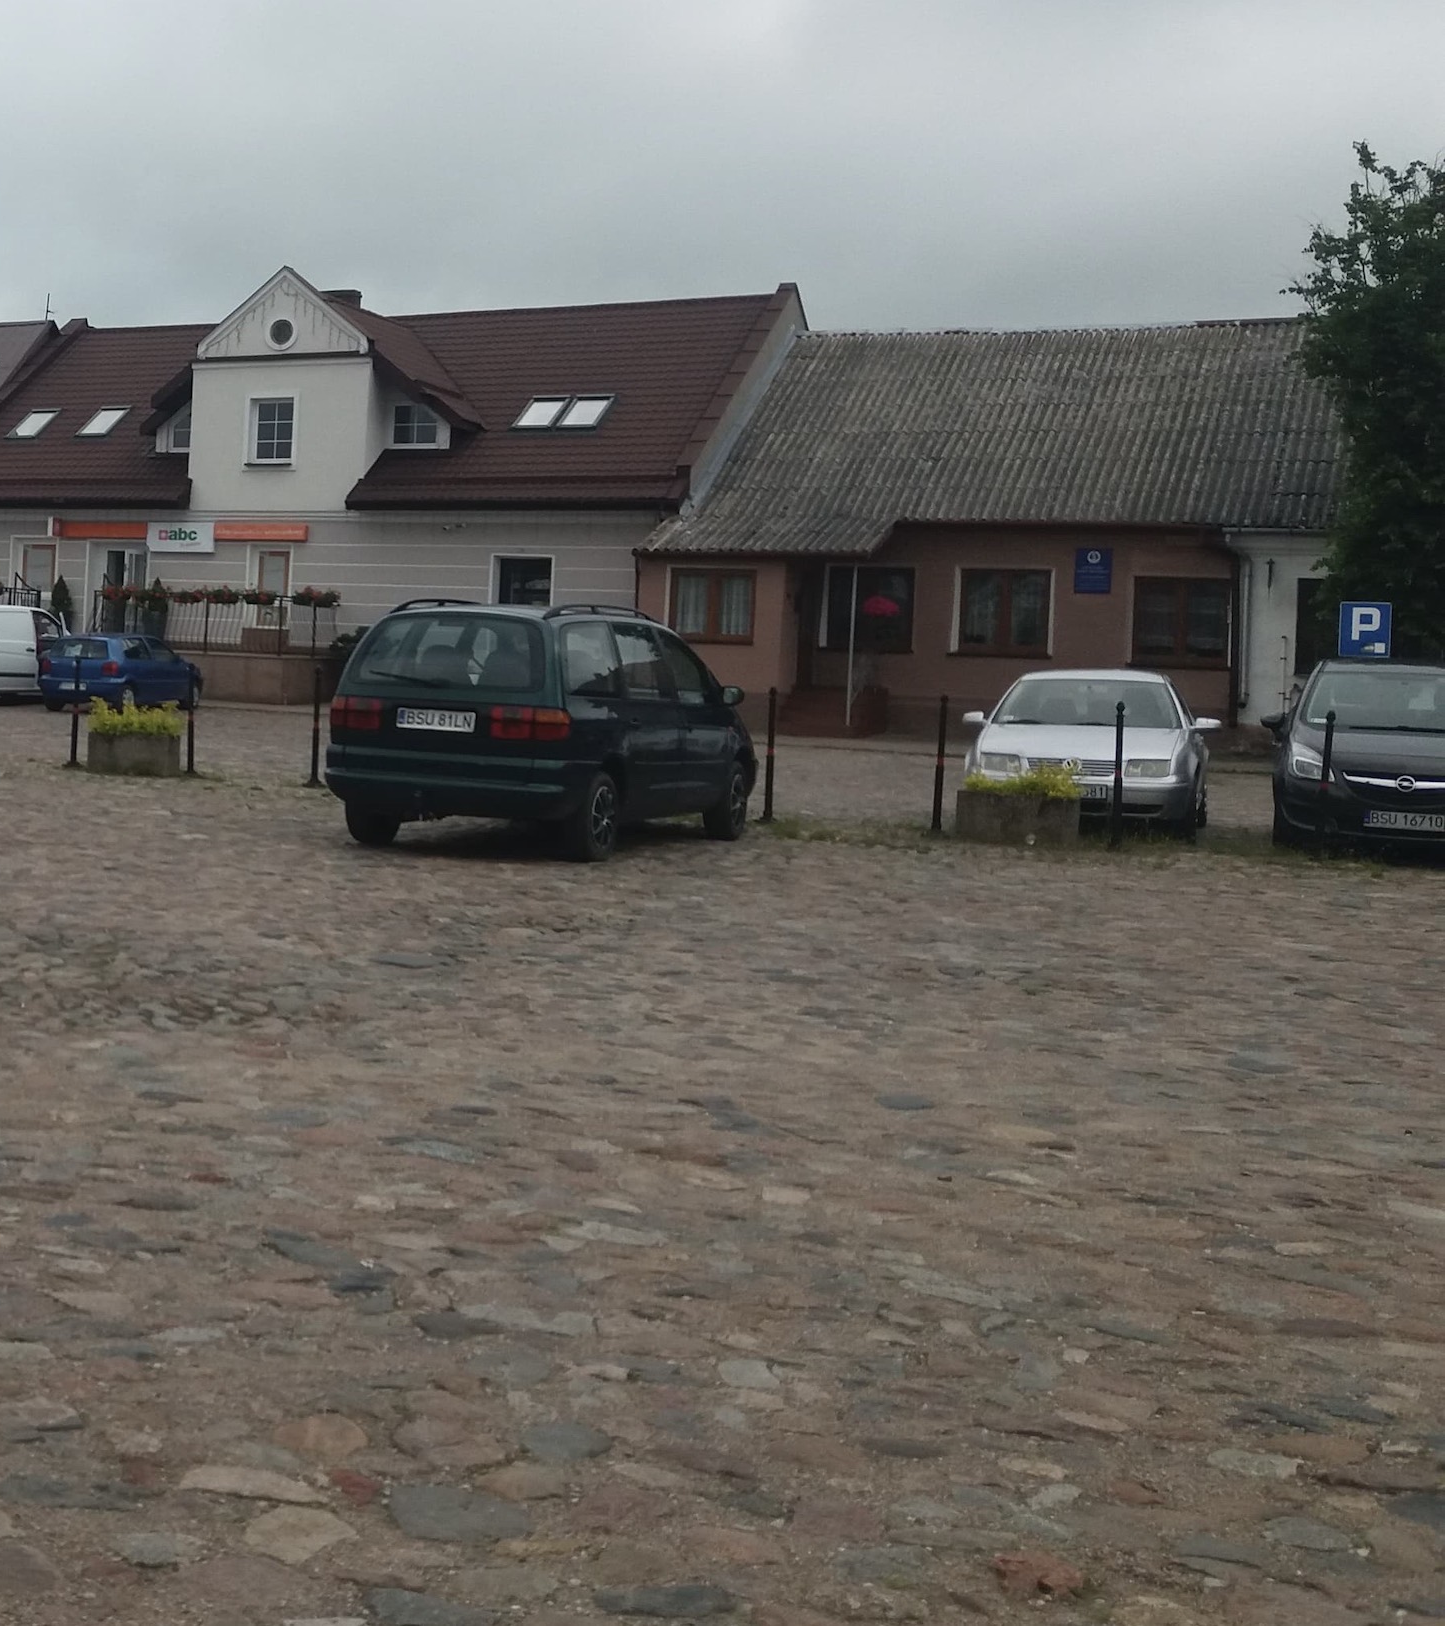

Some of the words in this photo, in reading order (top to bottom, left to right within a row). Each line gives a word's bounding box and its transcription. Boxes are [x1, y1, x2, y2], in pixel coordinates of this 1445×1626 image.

[169, 528, 197, 541] abc
[1351, 607, 1381, 641] P
[406, 711, 435, 726] BSU
[438, 713, 473, 729] 81LN
[1371, 812, 1397, 825] BSU
[1404, 814, 1444, 828] 16710
